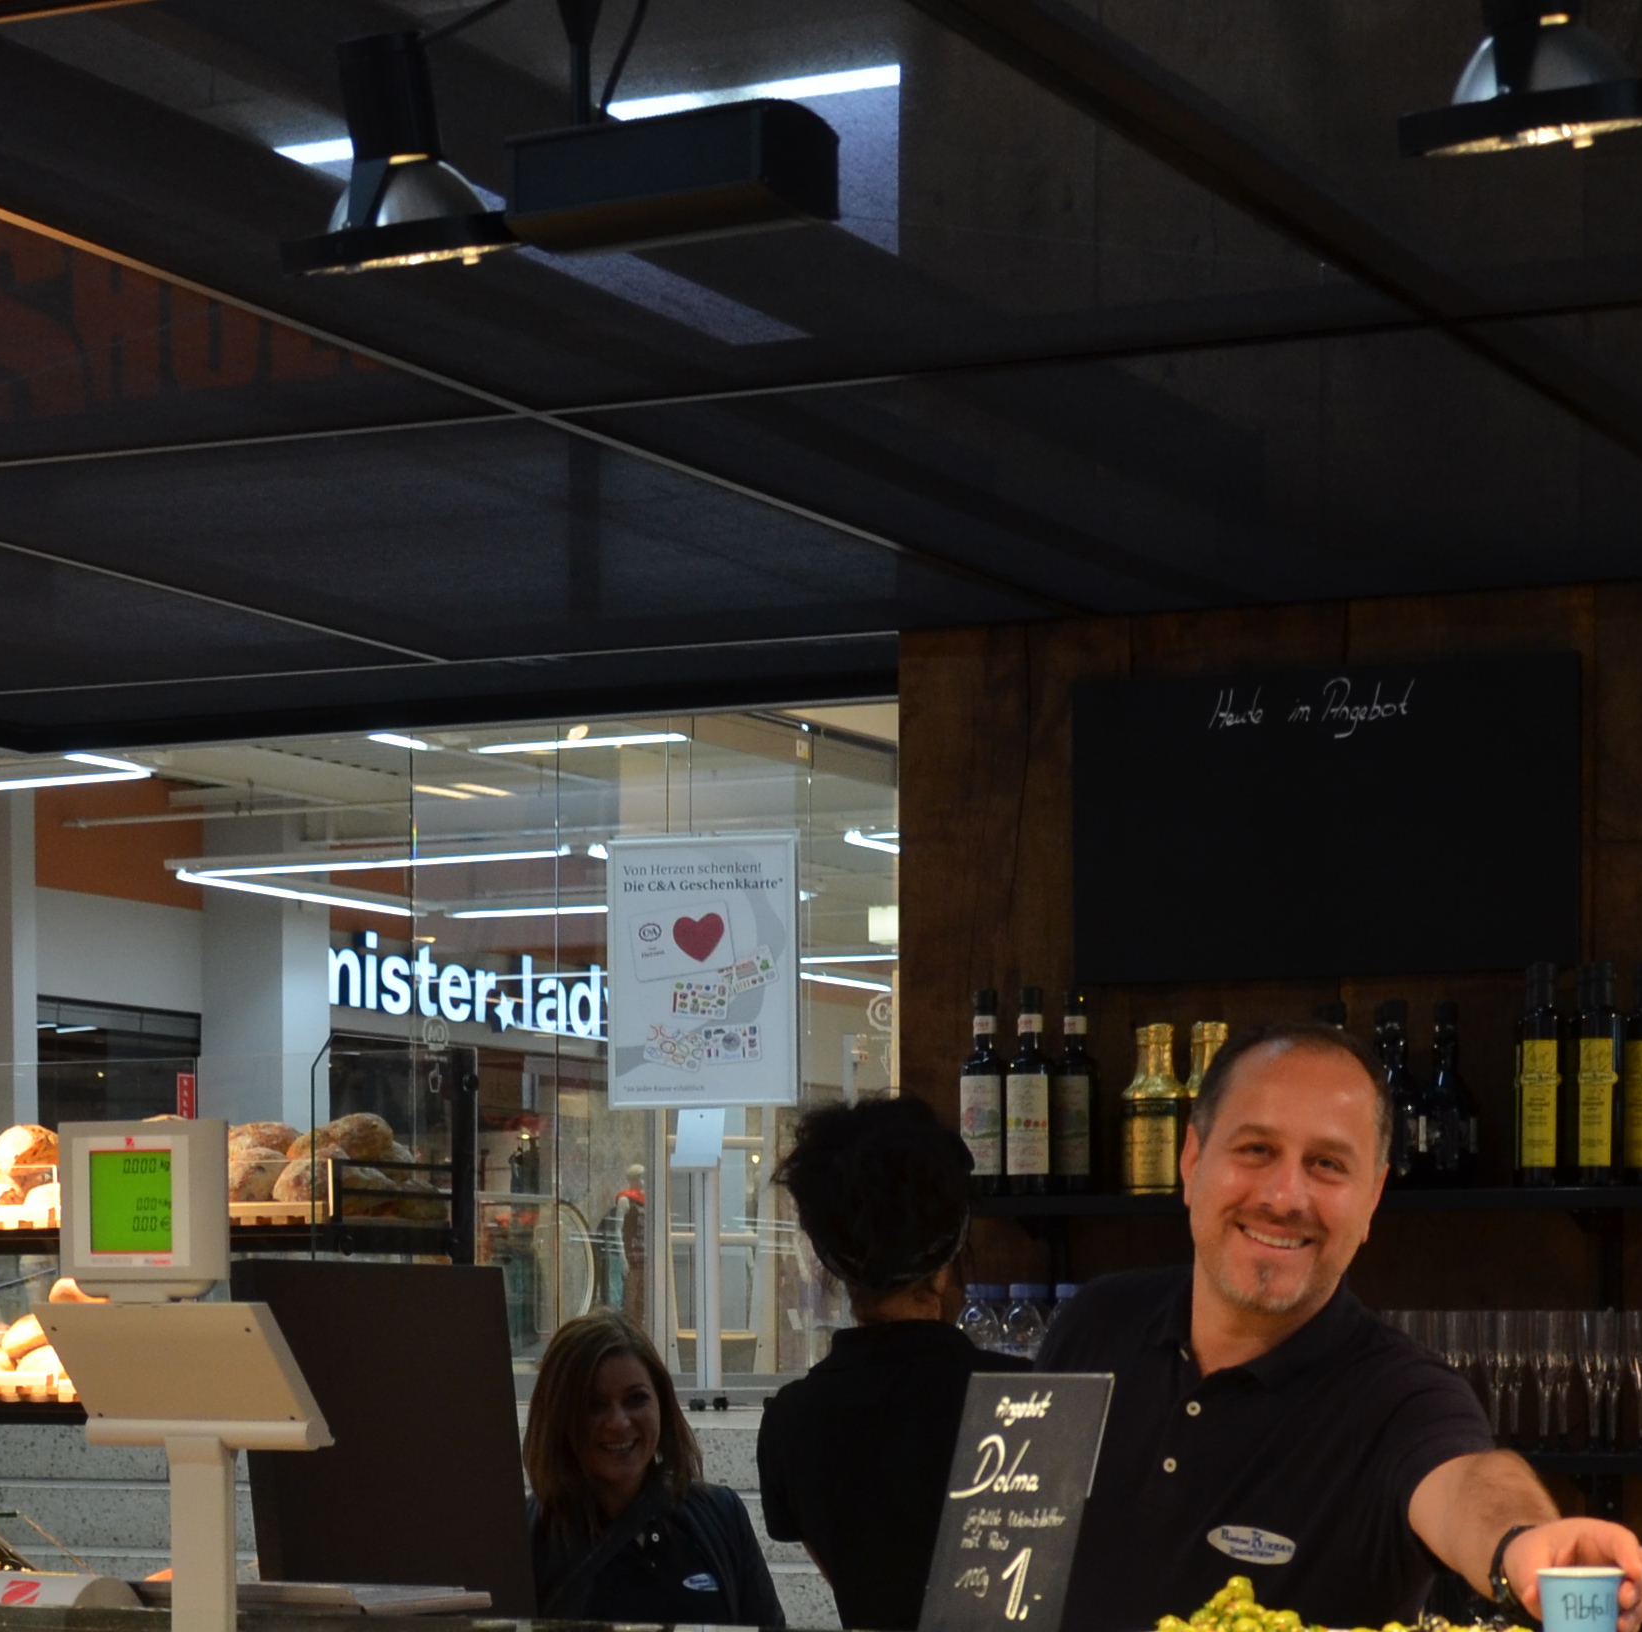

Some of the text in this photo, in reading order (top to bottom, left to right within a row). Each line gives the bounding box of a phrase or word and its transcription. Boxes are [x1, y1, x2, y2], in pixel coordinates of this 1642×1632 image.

[1208, 676, 1416, 740] Heute im Angebot
[622, 862, 762, 876] Von Herzen schenken!
[623, 881, 645, 893] Die
[647, 881, 676, 892] C&A
[521, 954, 609, 1038] lad
[949, 1433, 1040, 1499] Dolma
